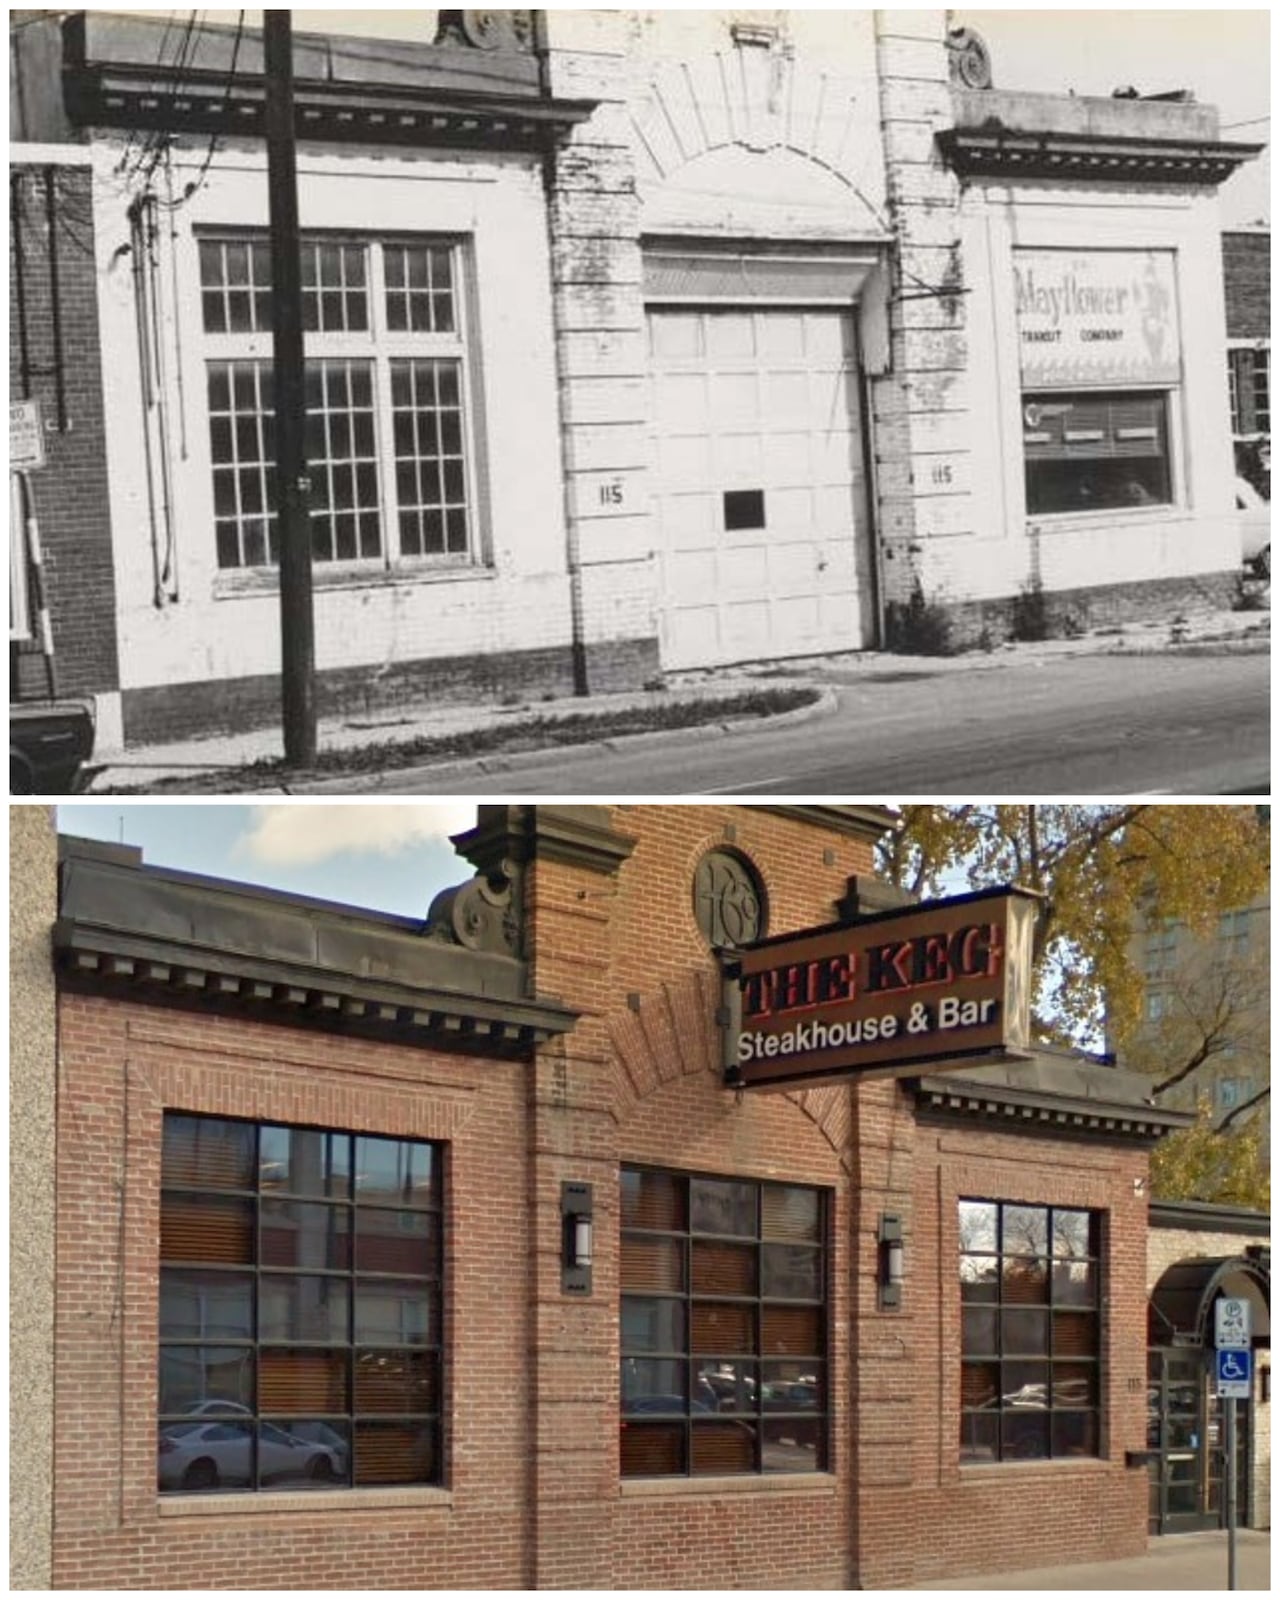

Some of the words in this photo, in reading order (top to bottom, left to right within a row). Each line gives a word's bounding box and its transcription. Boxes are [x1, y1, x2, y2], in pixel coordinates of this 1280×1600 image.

[600, 484, 623, 506] 115
[738, 951, 857, 1019] THE
[863, 922, 1002, 994] KEG
[736, 1013, 898, 1061] Steakhouse
[906, 1001, 929, 1034] &
[937, 995, 996, 1029] Bar
